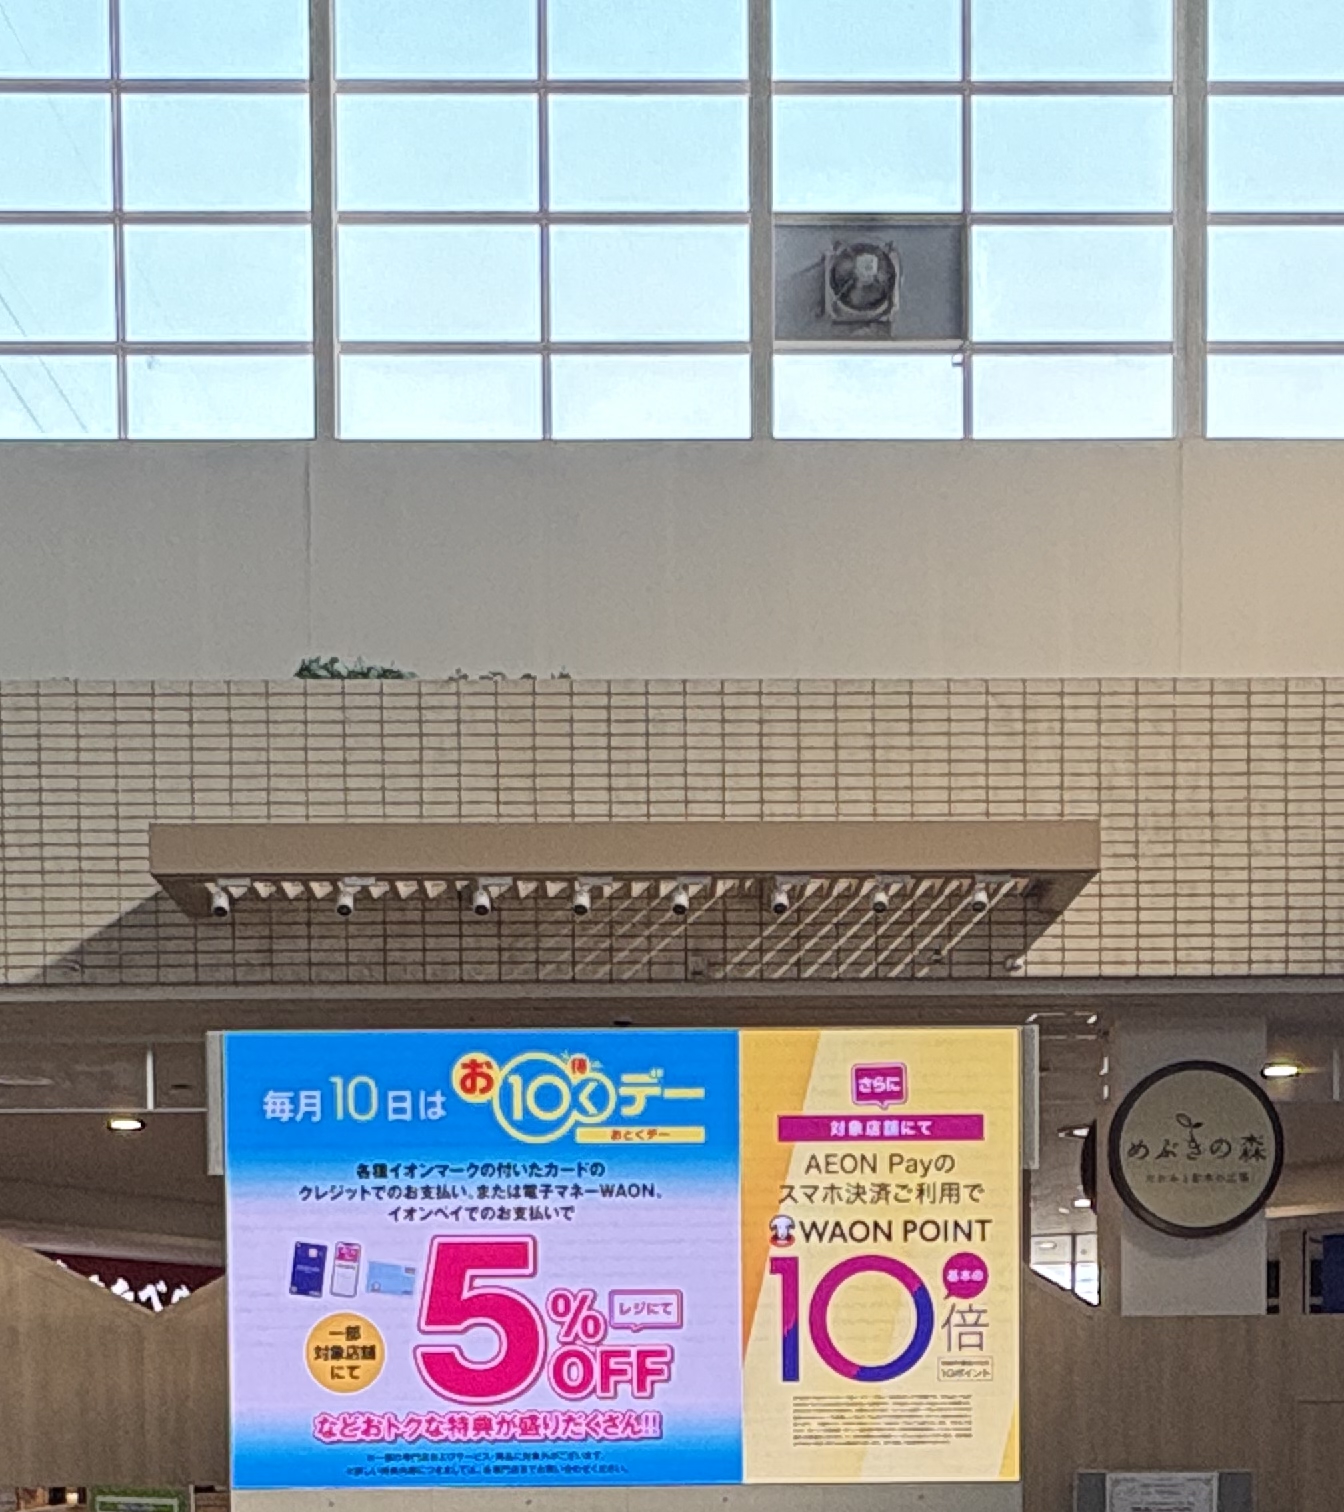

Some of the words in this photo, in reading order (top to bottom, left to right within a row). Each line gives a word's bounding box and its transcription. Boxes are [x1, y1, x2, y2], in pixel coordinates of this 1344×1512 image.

[858, 1076, 902, 1093] さらに
[262, 1075, 447, 1123] 毎月10日は
[1126, 1133, 1267, 1163] めぶきの森
[805, 1153, 878, 1174] AEON
[888, 1153, 956, 1177] Payの
[779, 1182, 986, 1205] スマホ決済ご利用で
[387, 1206, 576, 1222] イオンペイでのお支払いで
[800, 1219, 892, 1243] WAON
[904, 1219, 993, 1243] POINT
[619, 1302, 673, 1316] レジにて
[328, 1325, 362, 1342] 一部
[330, 1365, 362, 1380] にて
[548, 1347, 672, 1400] OFF
